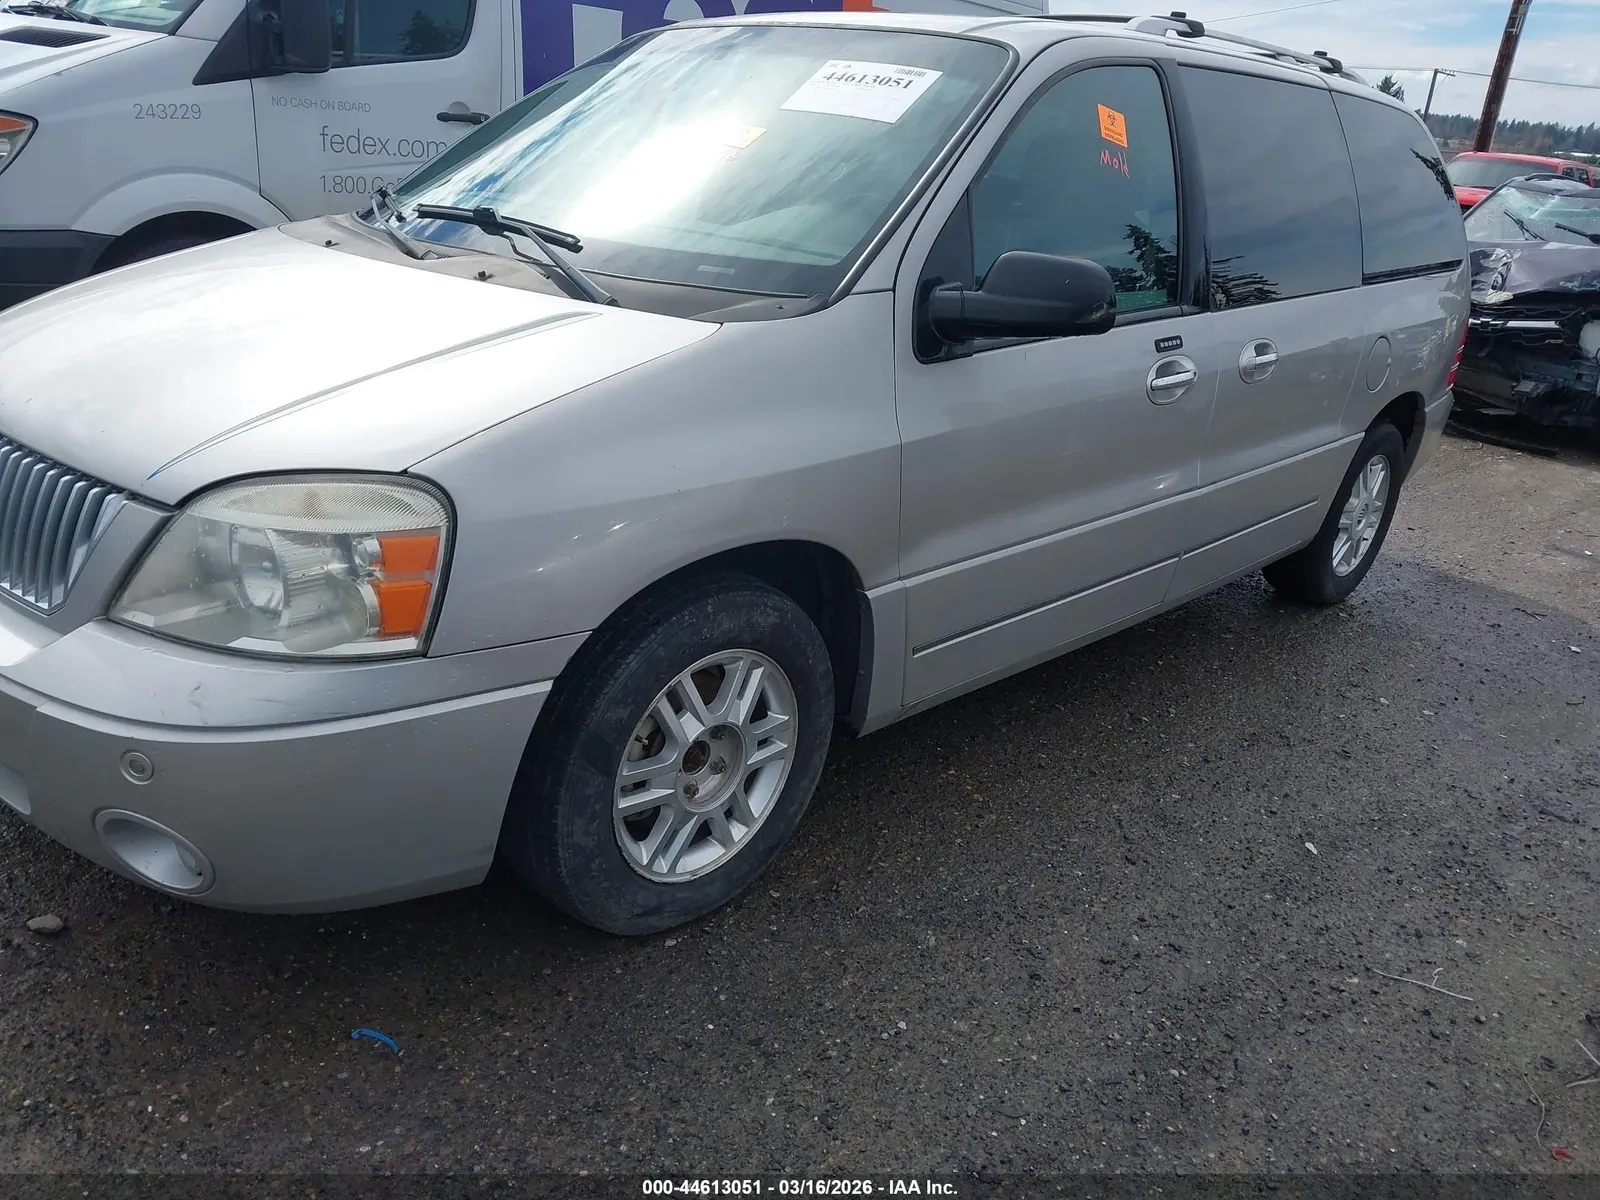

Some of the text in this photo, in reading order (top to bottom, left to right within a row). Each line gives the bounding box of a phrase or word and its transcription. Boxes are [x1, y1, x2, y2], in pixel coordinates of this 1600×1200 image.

[822, 71, 914, 90] 44613051
[132, 103, 202, 120] 243229
[271, 96, 371, 113] NO CASH ON BOARD
[319, 125, 448, 159] fedex.com
